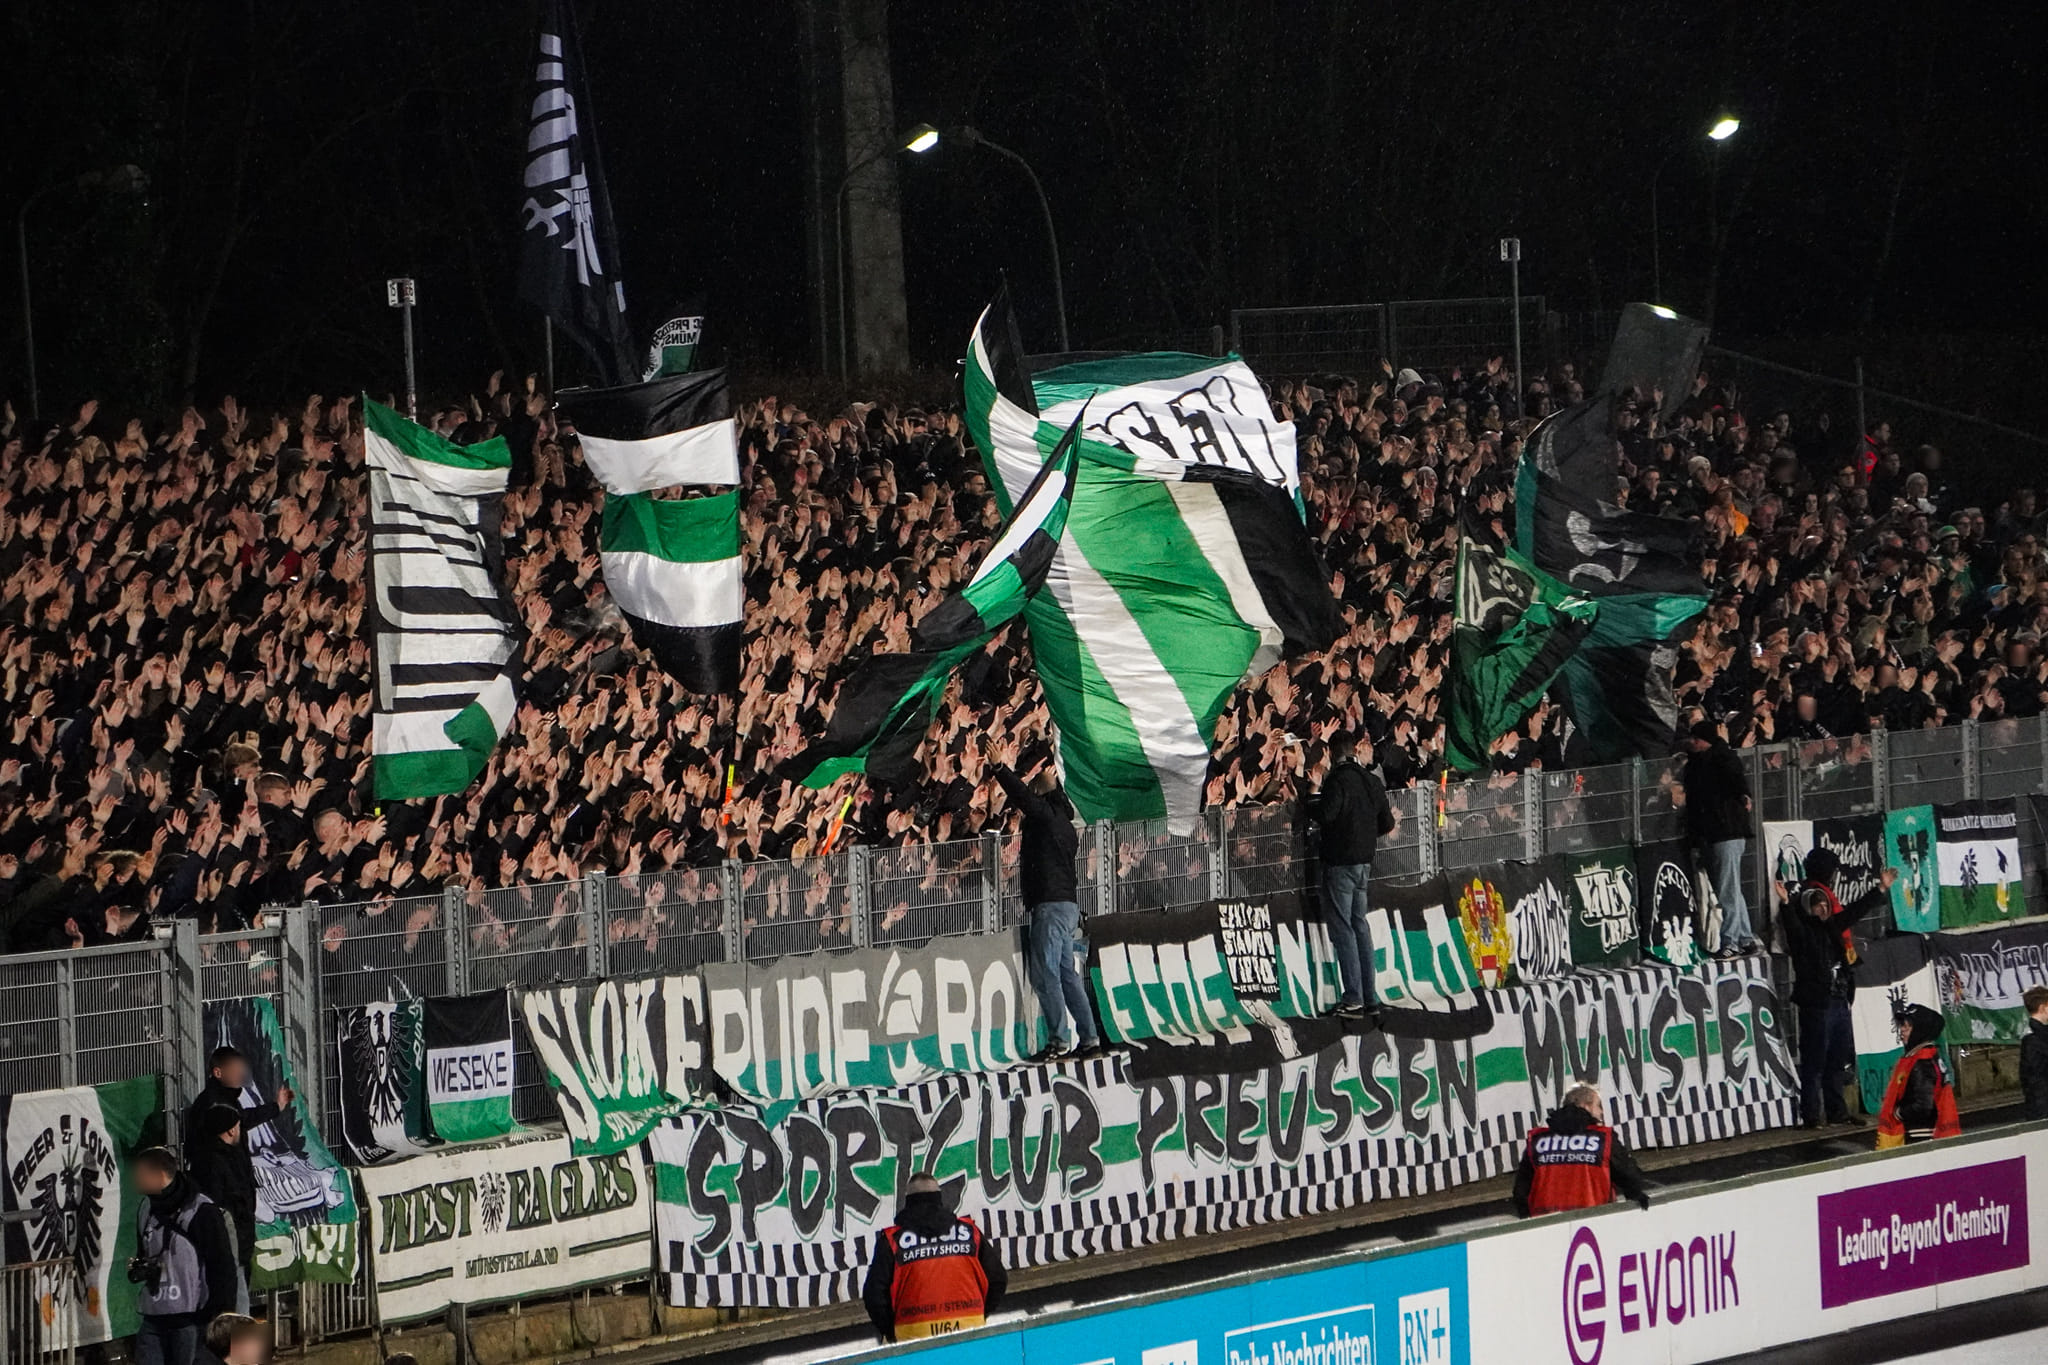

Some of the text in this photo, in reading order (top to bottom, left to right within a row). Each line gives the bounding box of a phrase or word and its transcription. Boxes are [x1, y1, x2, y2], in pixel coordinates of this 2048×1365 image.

[432, 1051, 508, 1093] WESEKE
[1136, 1027, 1480, 1197] PREUSSEN
[12, 1127, 55, 1196] BEER
[80, 1116, 116, 1184] LOVE
[378, 1152, 637, 1254] WEST EAGLES
[1837, 1196, 2010, 1270] Leading Beyond Chemistry
[465, 1246, 559, 1279] MÜNSTERLAND
[903, 1244, 970, 1262] SAFETY SHOES
[1618, 1230, 1739, 1334] EVONIK
